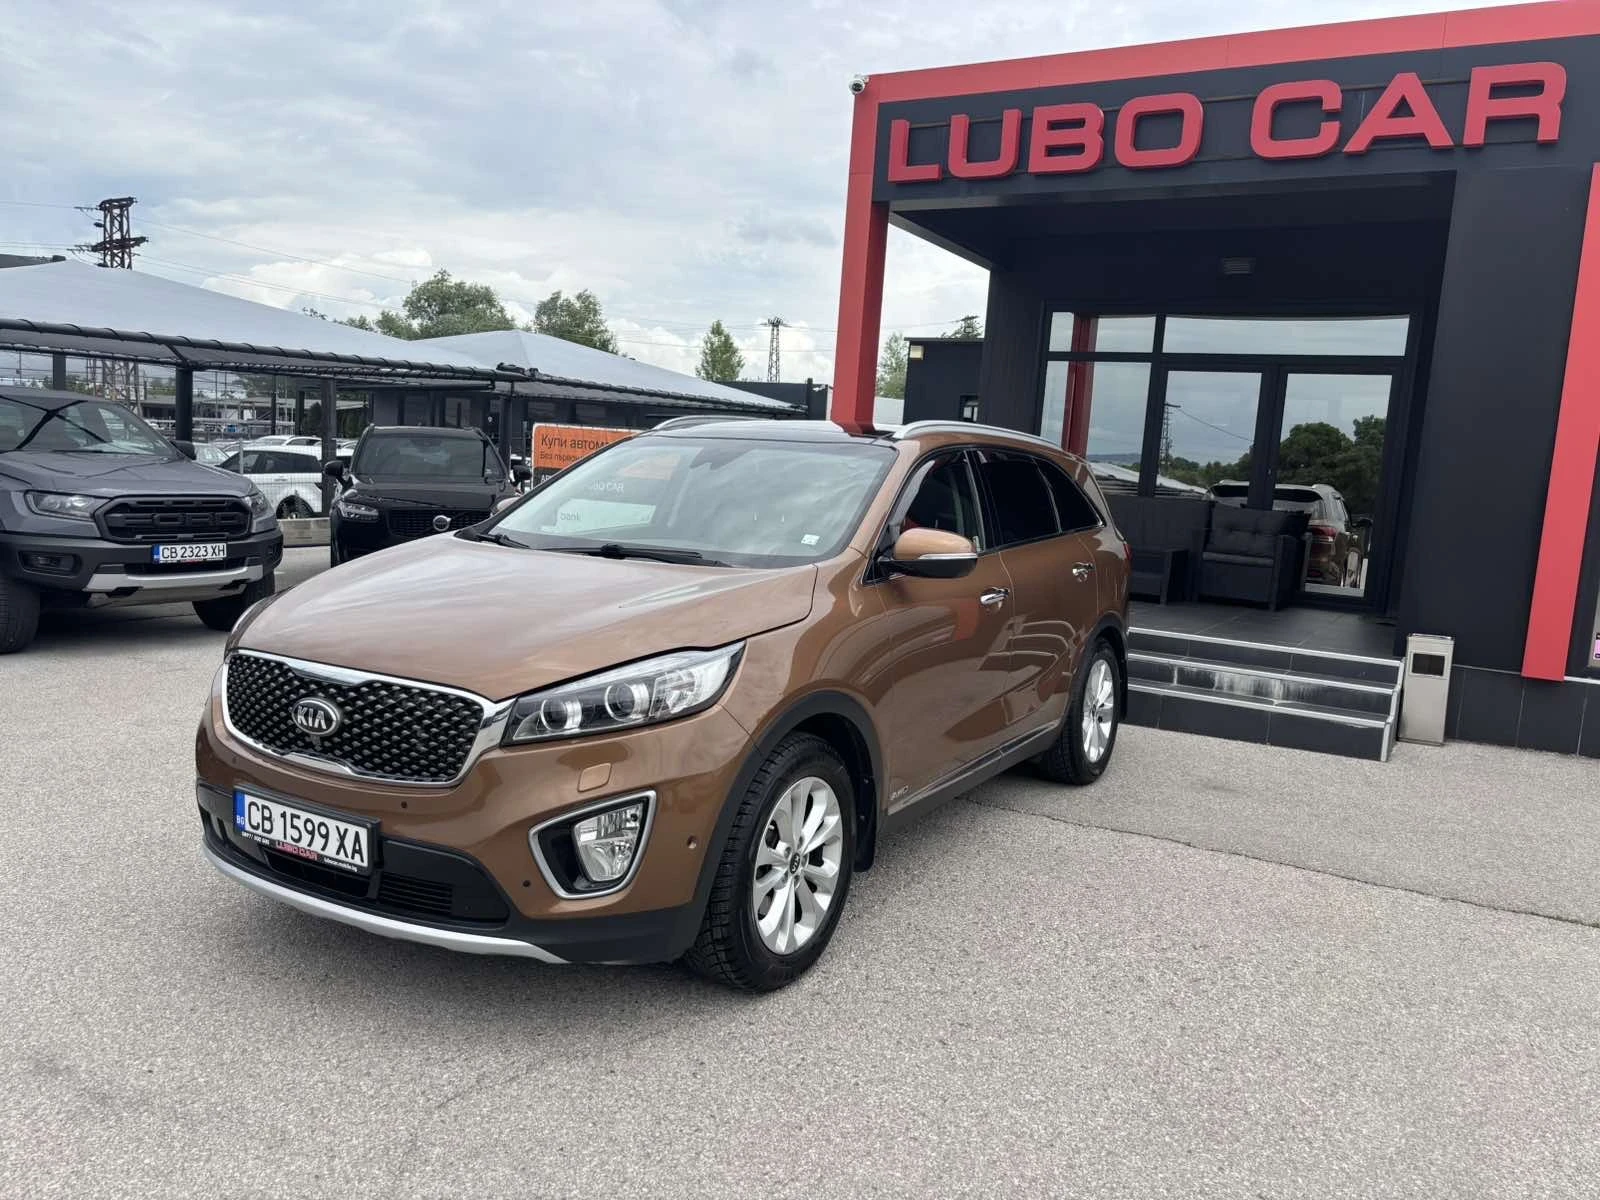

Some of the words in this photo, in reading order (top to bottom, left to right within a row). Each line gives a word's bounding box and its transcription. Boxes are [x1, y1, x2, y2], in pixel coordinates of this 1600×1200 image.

[887, 91, 1204, 184] LUBO
[1250, 61, 1568, 160] CAR
[541, 434, 567, 450] Купи
[161, 546, 178, 559] CB
[180, 545, 209, 558] 2323
[211, 544, 226, 557] XH
[297, 705, 327, 730] KIA
[247, 801, 274, 835] CB
[280, 810, 330, 852] 1599
[335, 825, 365, 864] XA
